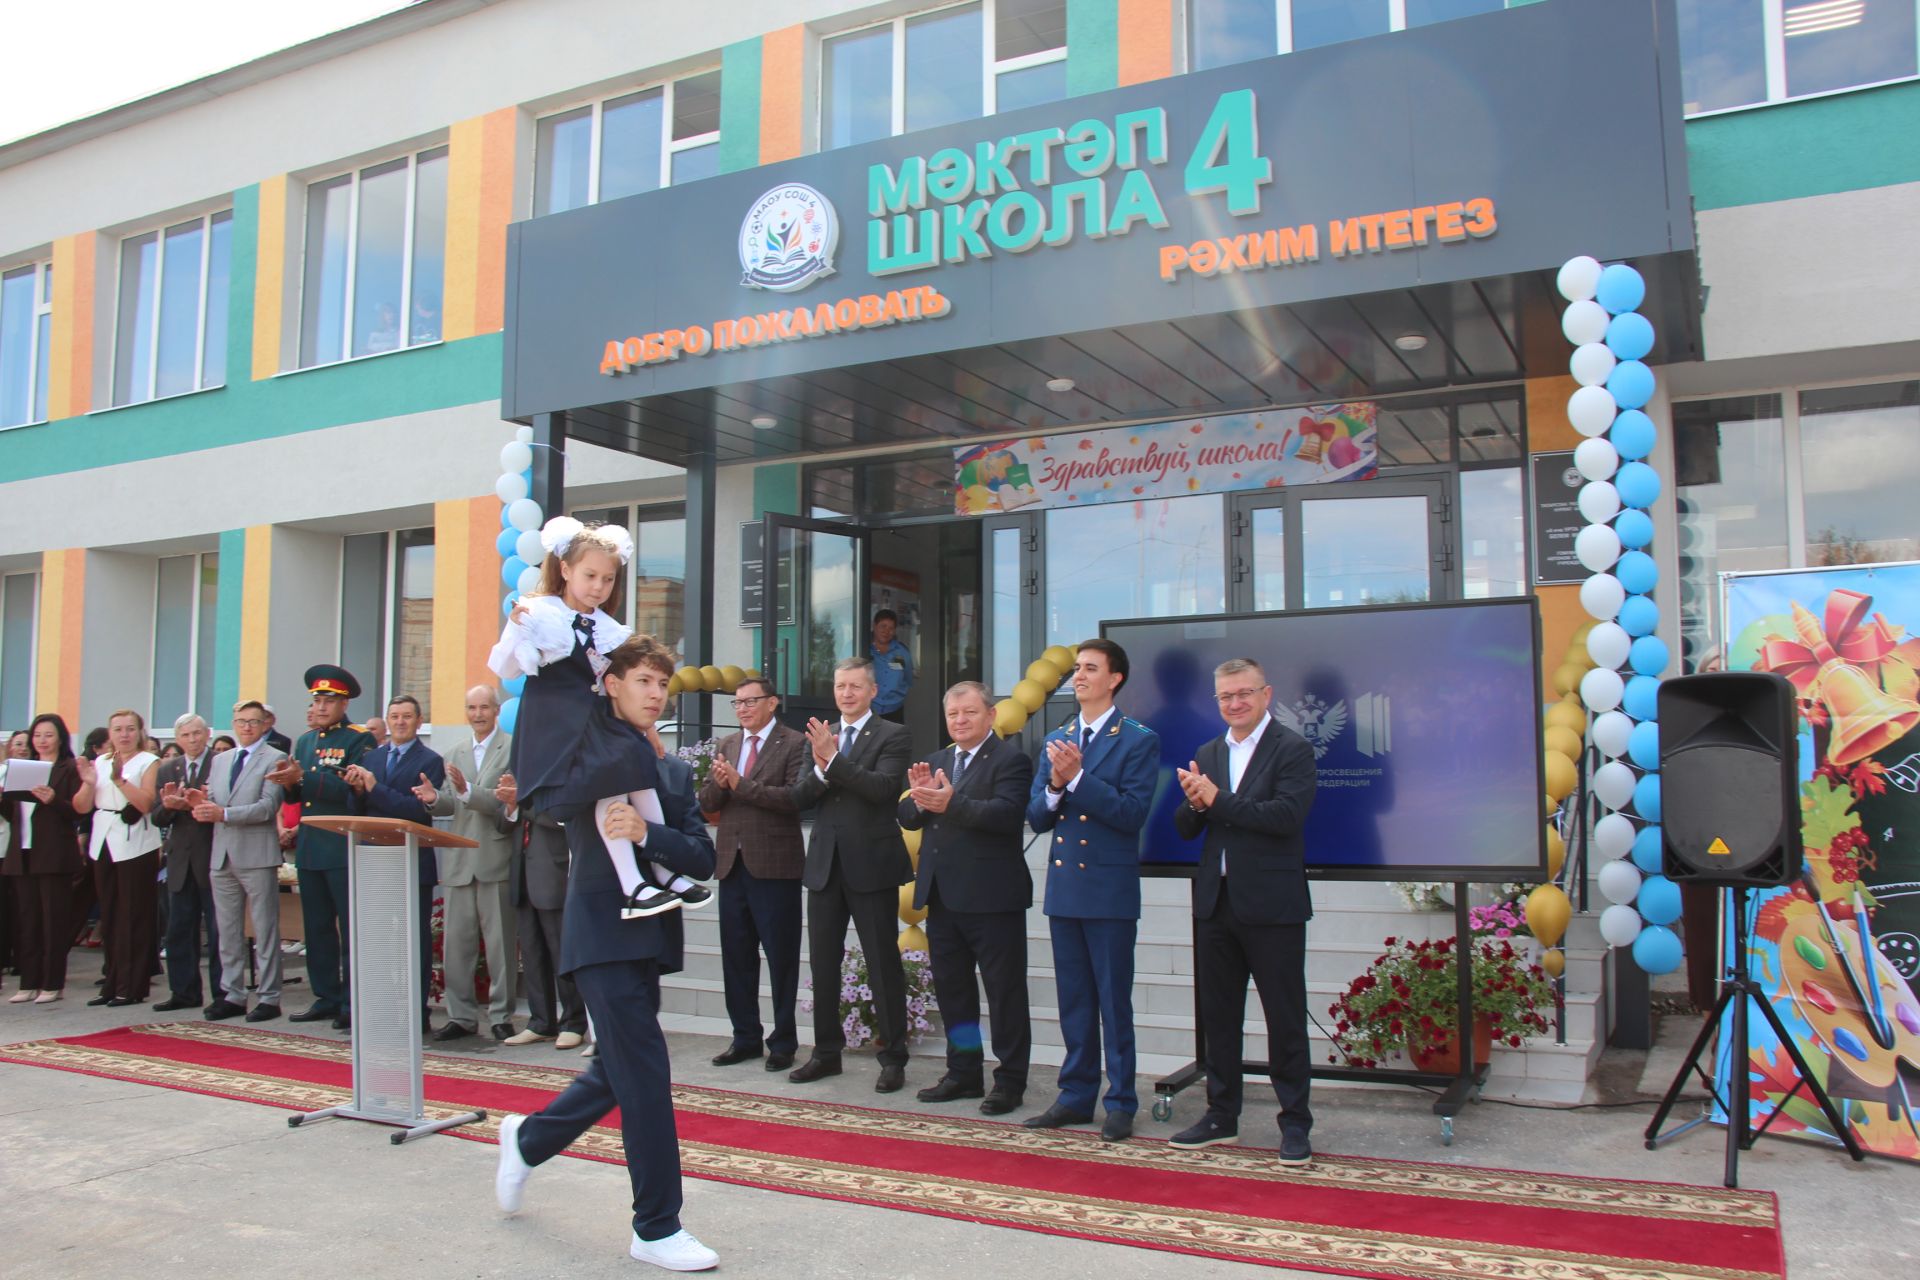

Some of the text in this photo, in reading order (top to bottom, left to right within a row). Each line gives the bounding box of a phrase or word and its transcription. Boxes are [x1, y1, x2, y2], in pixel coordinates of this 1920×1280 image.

[868, 106, 1167, 217] МӘКТӘП
[1184, 88, 1272, 217] 4
[753, 193, 782, 219] МАОУ
[784, 190, 809, 202] СОШ
[868, 169, 1169, 277] ШКОЛА
[1160, 198, 1497, 282] РӘХИМ ИТЕГЕЗ
[600, 285, 950, 376] ДОБРО ПОЖАЛОВАТЬ
[1038, 428, 1293, 492] Здравствуй, школа!
[1316, 768, 1383, 776] ПРОСВЕЩЕНИЯ
